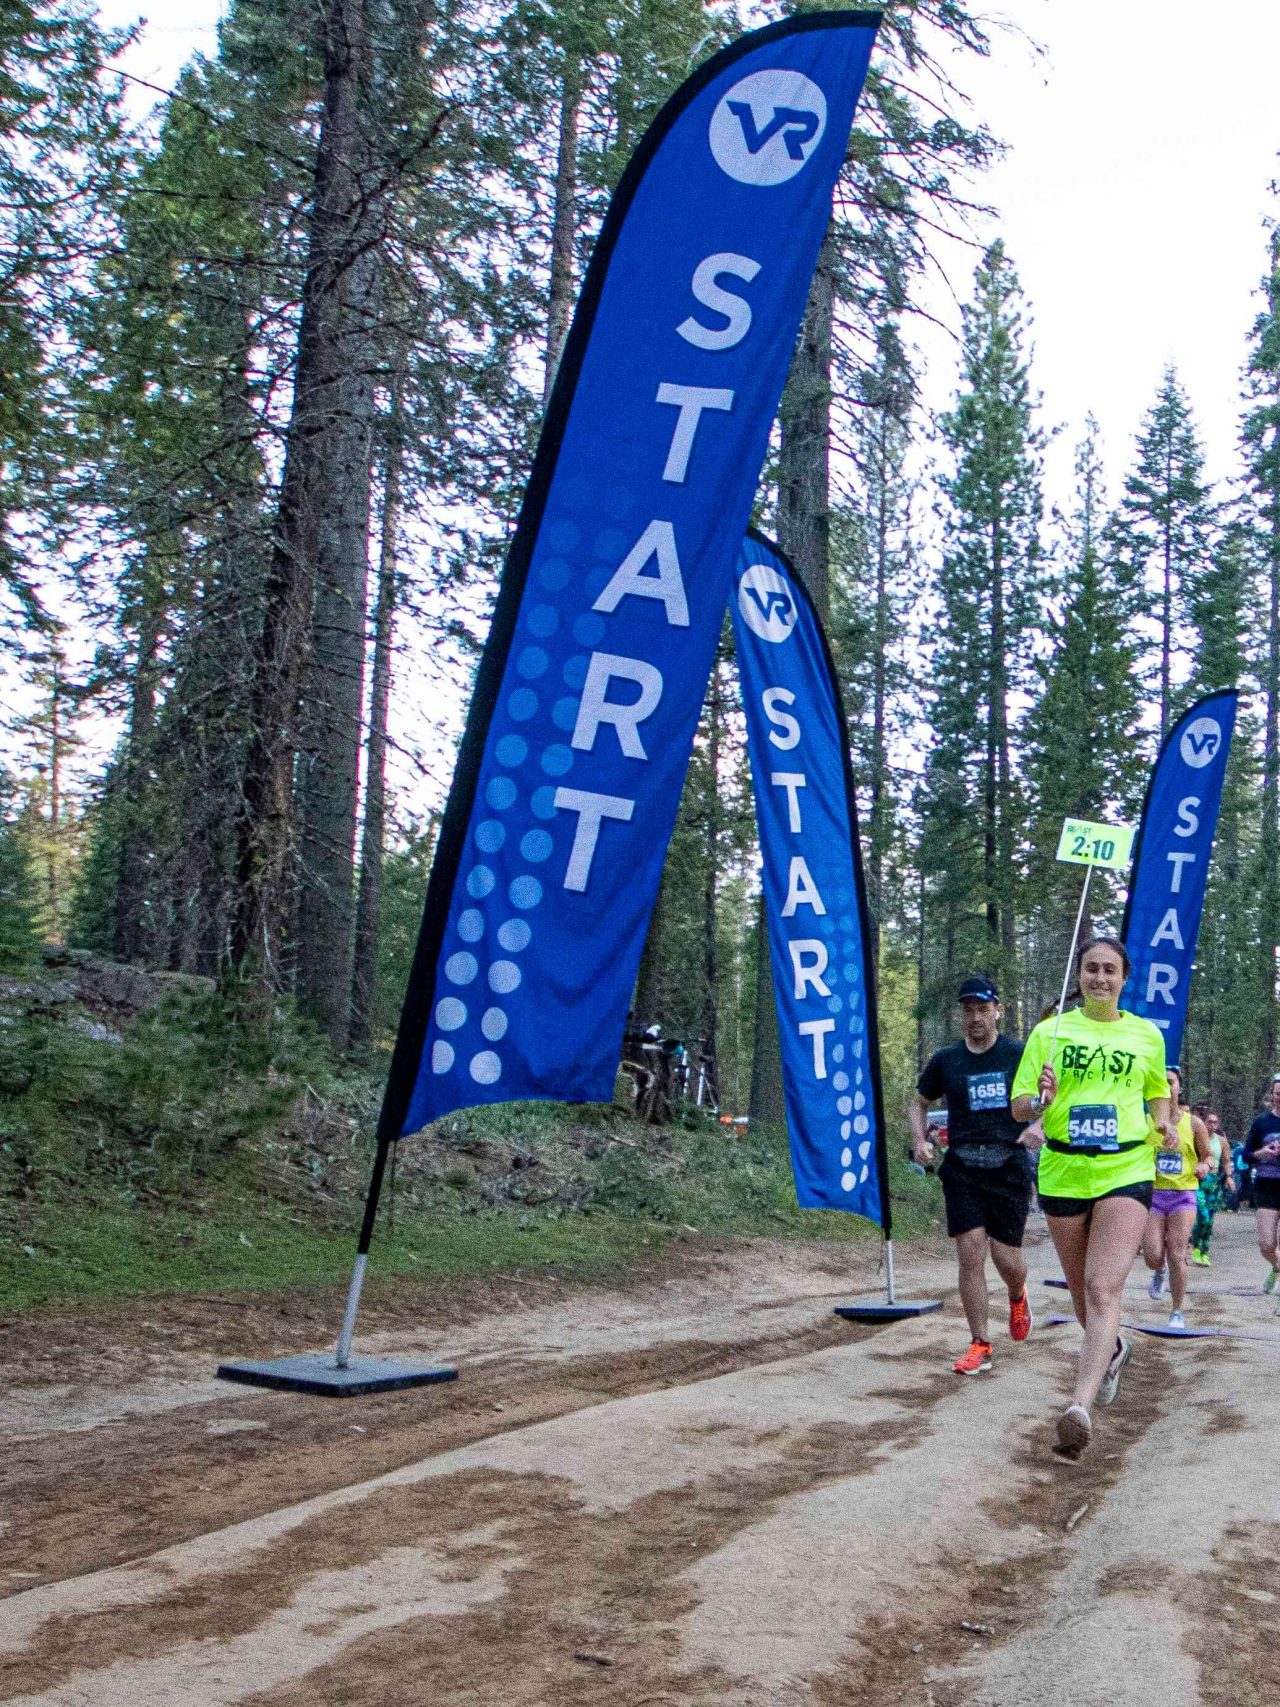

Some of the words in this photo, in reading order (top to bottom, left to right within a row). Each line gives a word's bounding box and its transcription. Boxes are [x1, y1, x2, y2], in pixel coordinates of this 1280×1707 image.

[726, 100, 820, 161] VR
[553, 251, 763, 893] START
[746, 586, 792, 627] VR
[1186, 732, 1219, 756] VR
[1071, 836, 1115, 861] 2:10
[761, 686, 836, 1080] START
[1062, 1044, 1136, 1080] BEAST
[969, 1082, 1006, 1099] 1655
[1061, 1068, 1132, 1088] PACING
[1068, 1118, 1118, 1138] 5458
